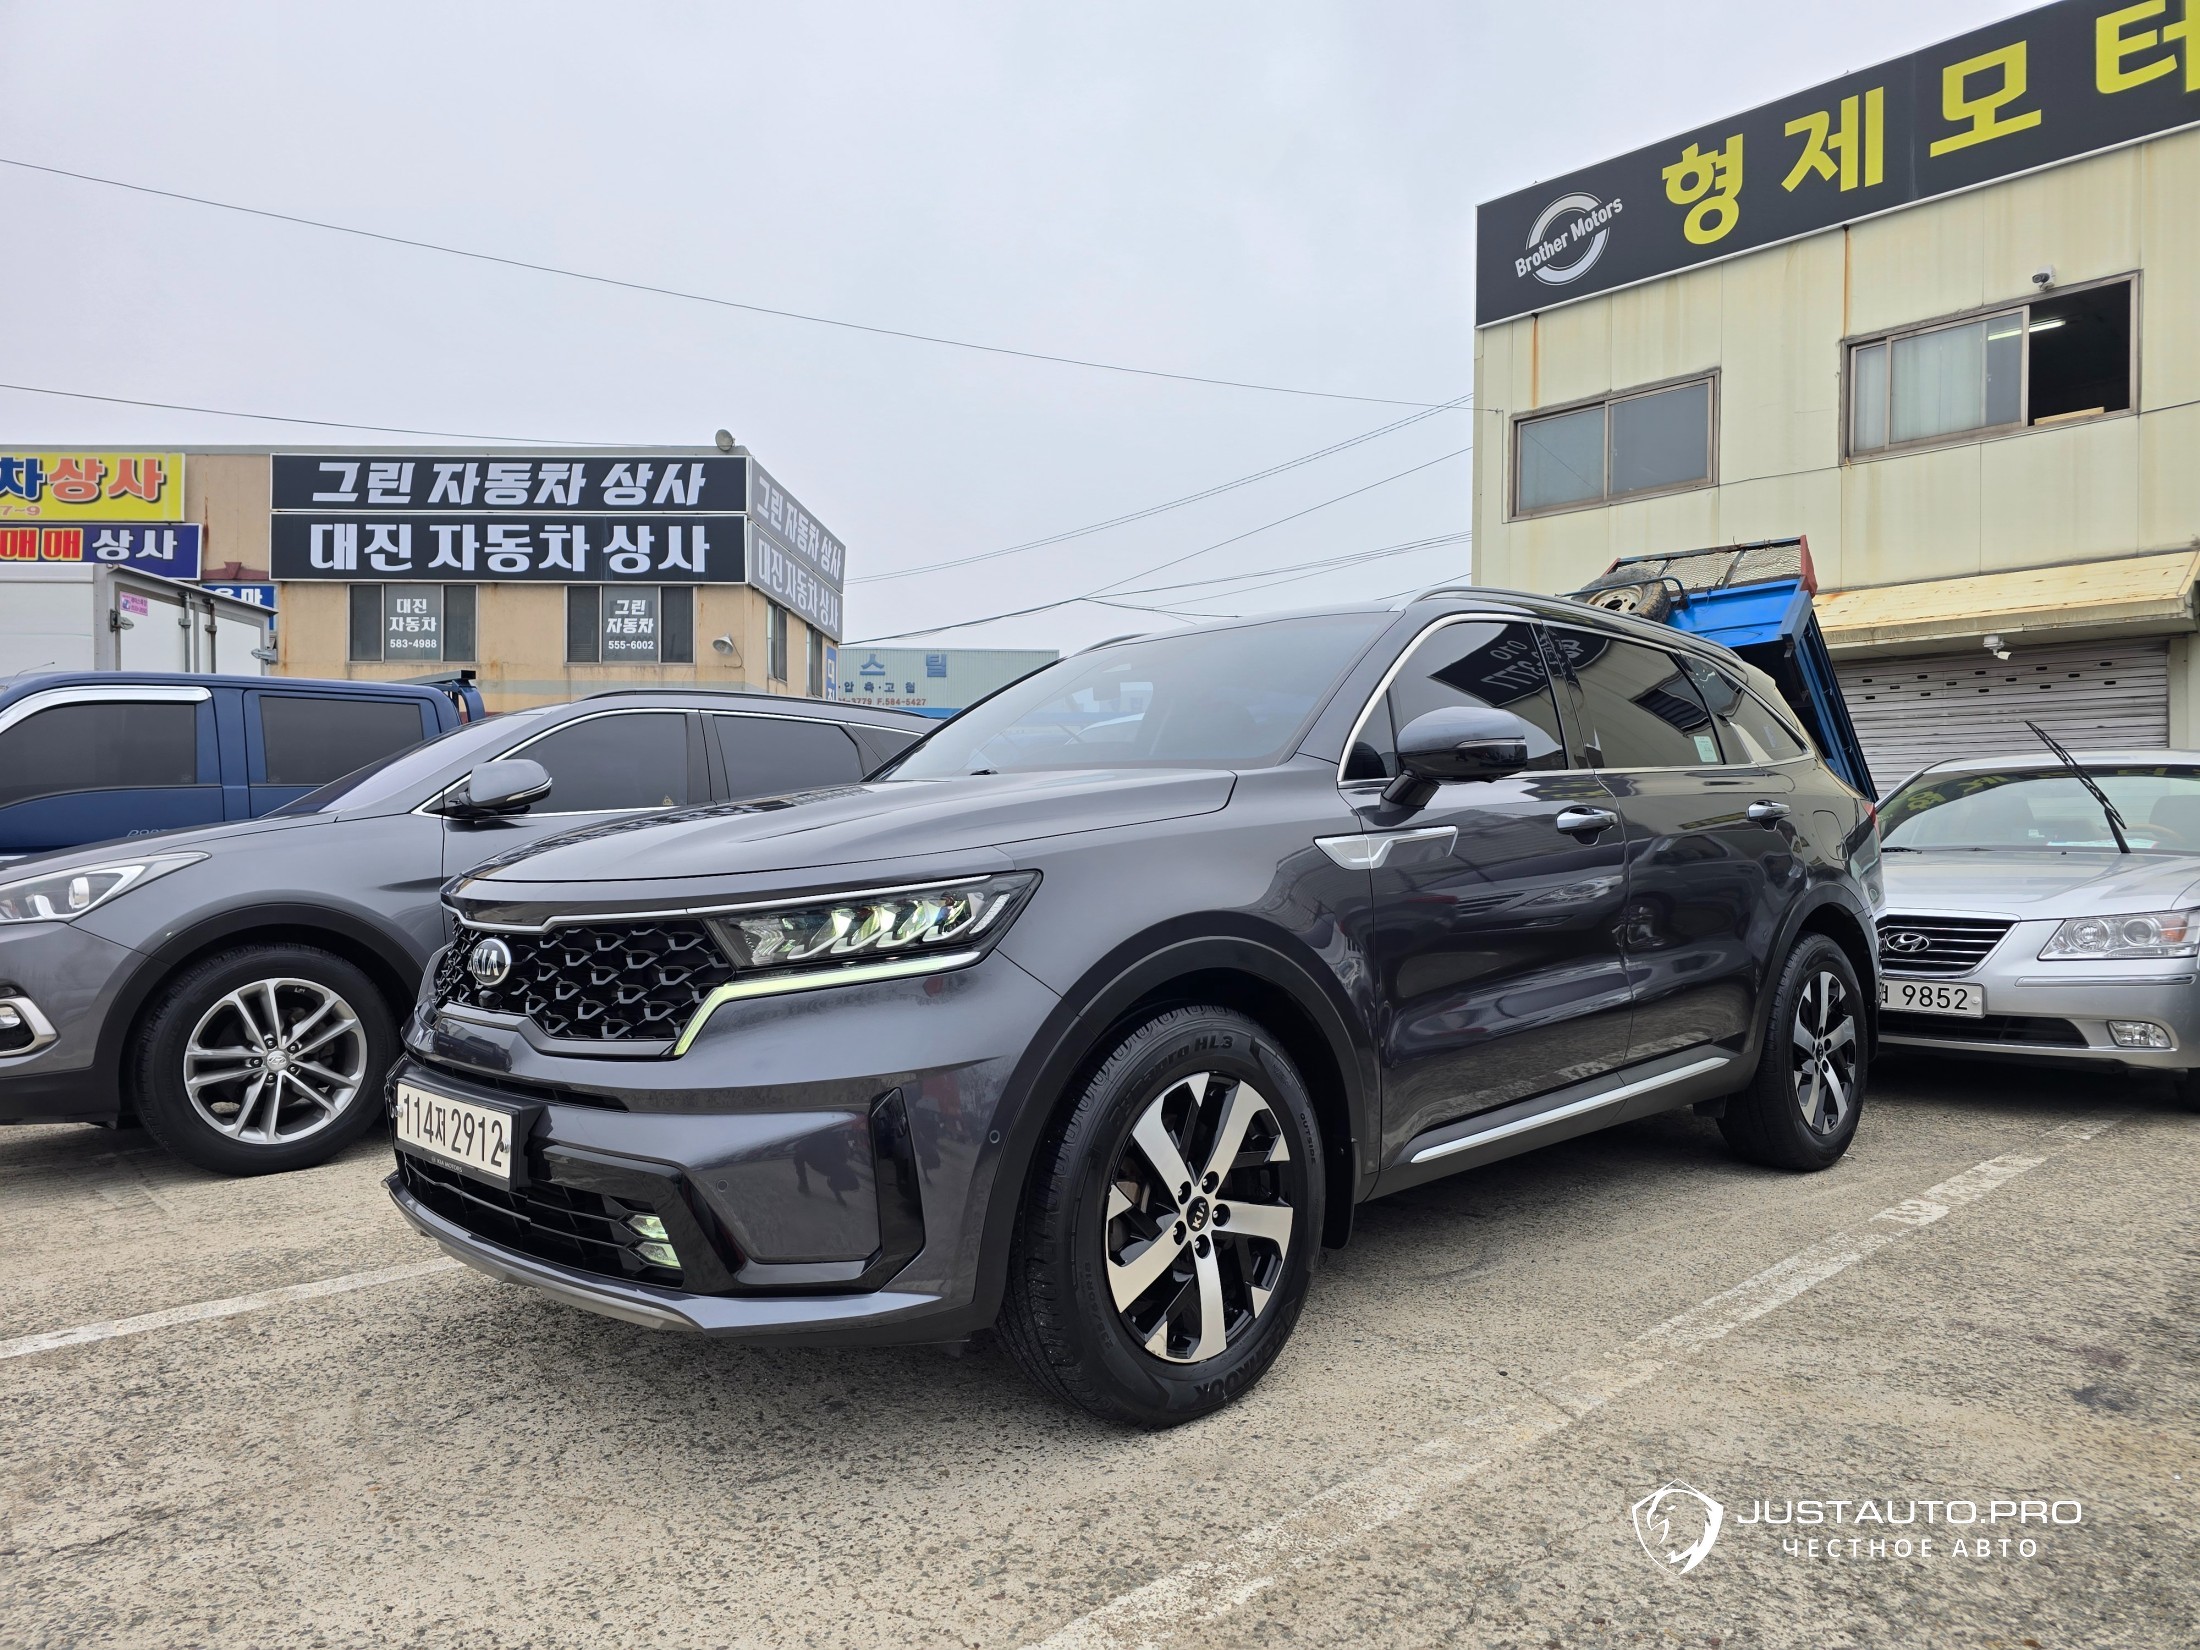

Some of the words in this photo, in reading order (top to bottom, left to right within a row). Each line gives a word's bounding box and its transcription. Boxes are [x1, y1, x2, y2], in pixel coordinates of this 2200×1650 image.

[1514, 232, 1568, 278] Brother
[1570, 198, 1623, 242] Motors
[312, 461, 416, 504] 그린
[427, 462, 587, 506] 자동차
[600, 463, 707, 506] 상사
[756, 475, 783, 531] 그린
[785, 501, 820, 562] 자동차
[821, 535, 842, 581] 상사
[92, 529, 178, 560] 상사
[310, 523, 413, 572] 대진
[428, 524, 590, 572] 자동차
[603, 525, 710, 573] 상사
[758, 537, 783, 593] 대진
[785, 559, 818, 619] 자동차
[820, 585, 839, 632] 상사
[396, 598, 427, 614] 대진
[615, 599, 646, 615] 그린
[389, 616, 437, 632] 자동차
[606, 617, 654, 634] 자동차
[390, 638, 437, 649] 583-4988
[608, 640, 654, 650] 555-6002
[473, 948, 500, 976] KIA
[1902, 985, 1968, 1011] 9852
[1194, 1035, 1234, 1052] HL3
[1299, 1112, 1317, 1165] OUTSIDE
[1192, 1202, 1206, 1229] KIA
